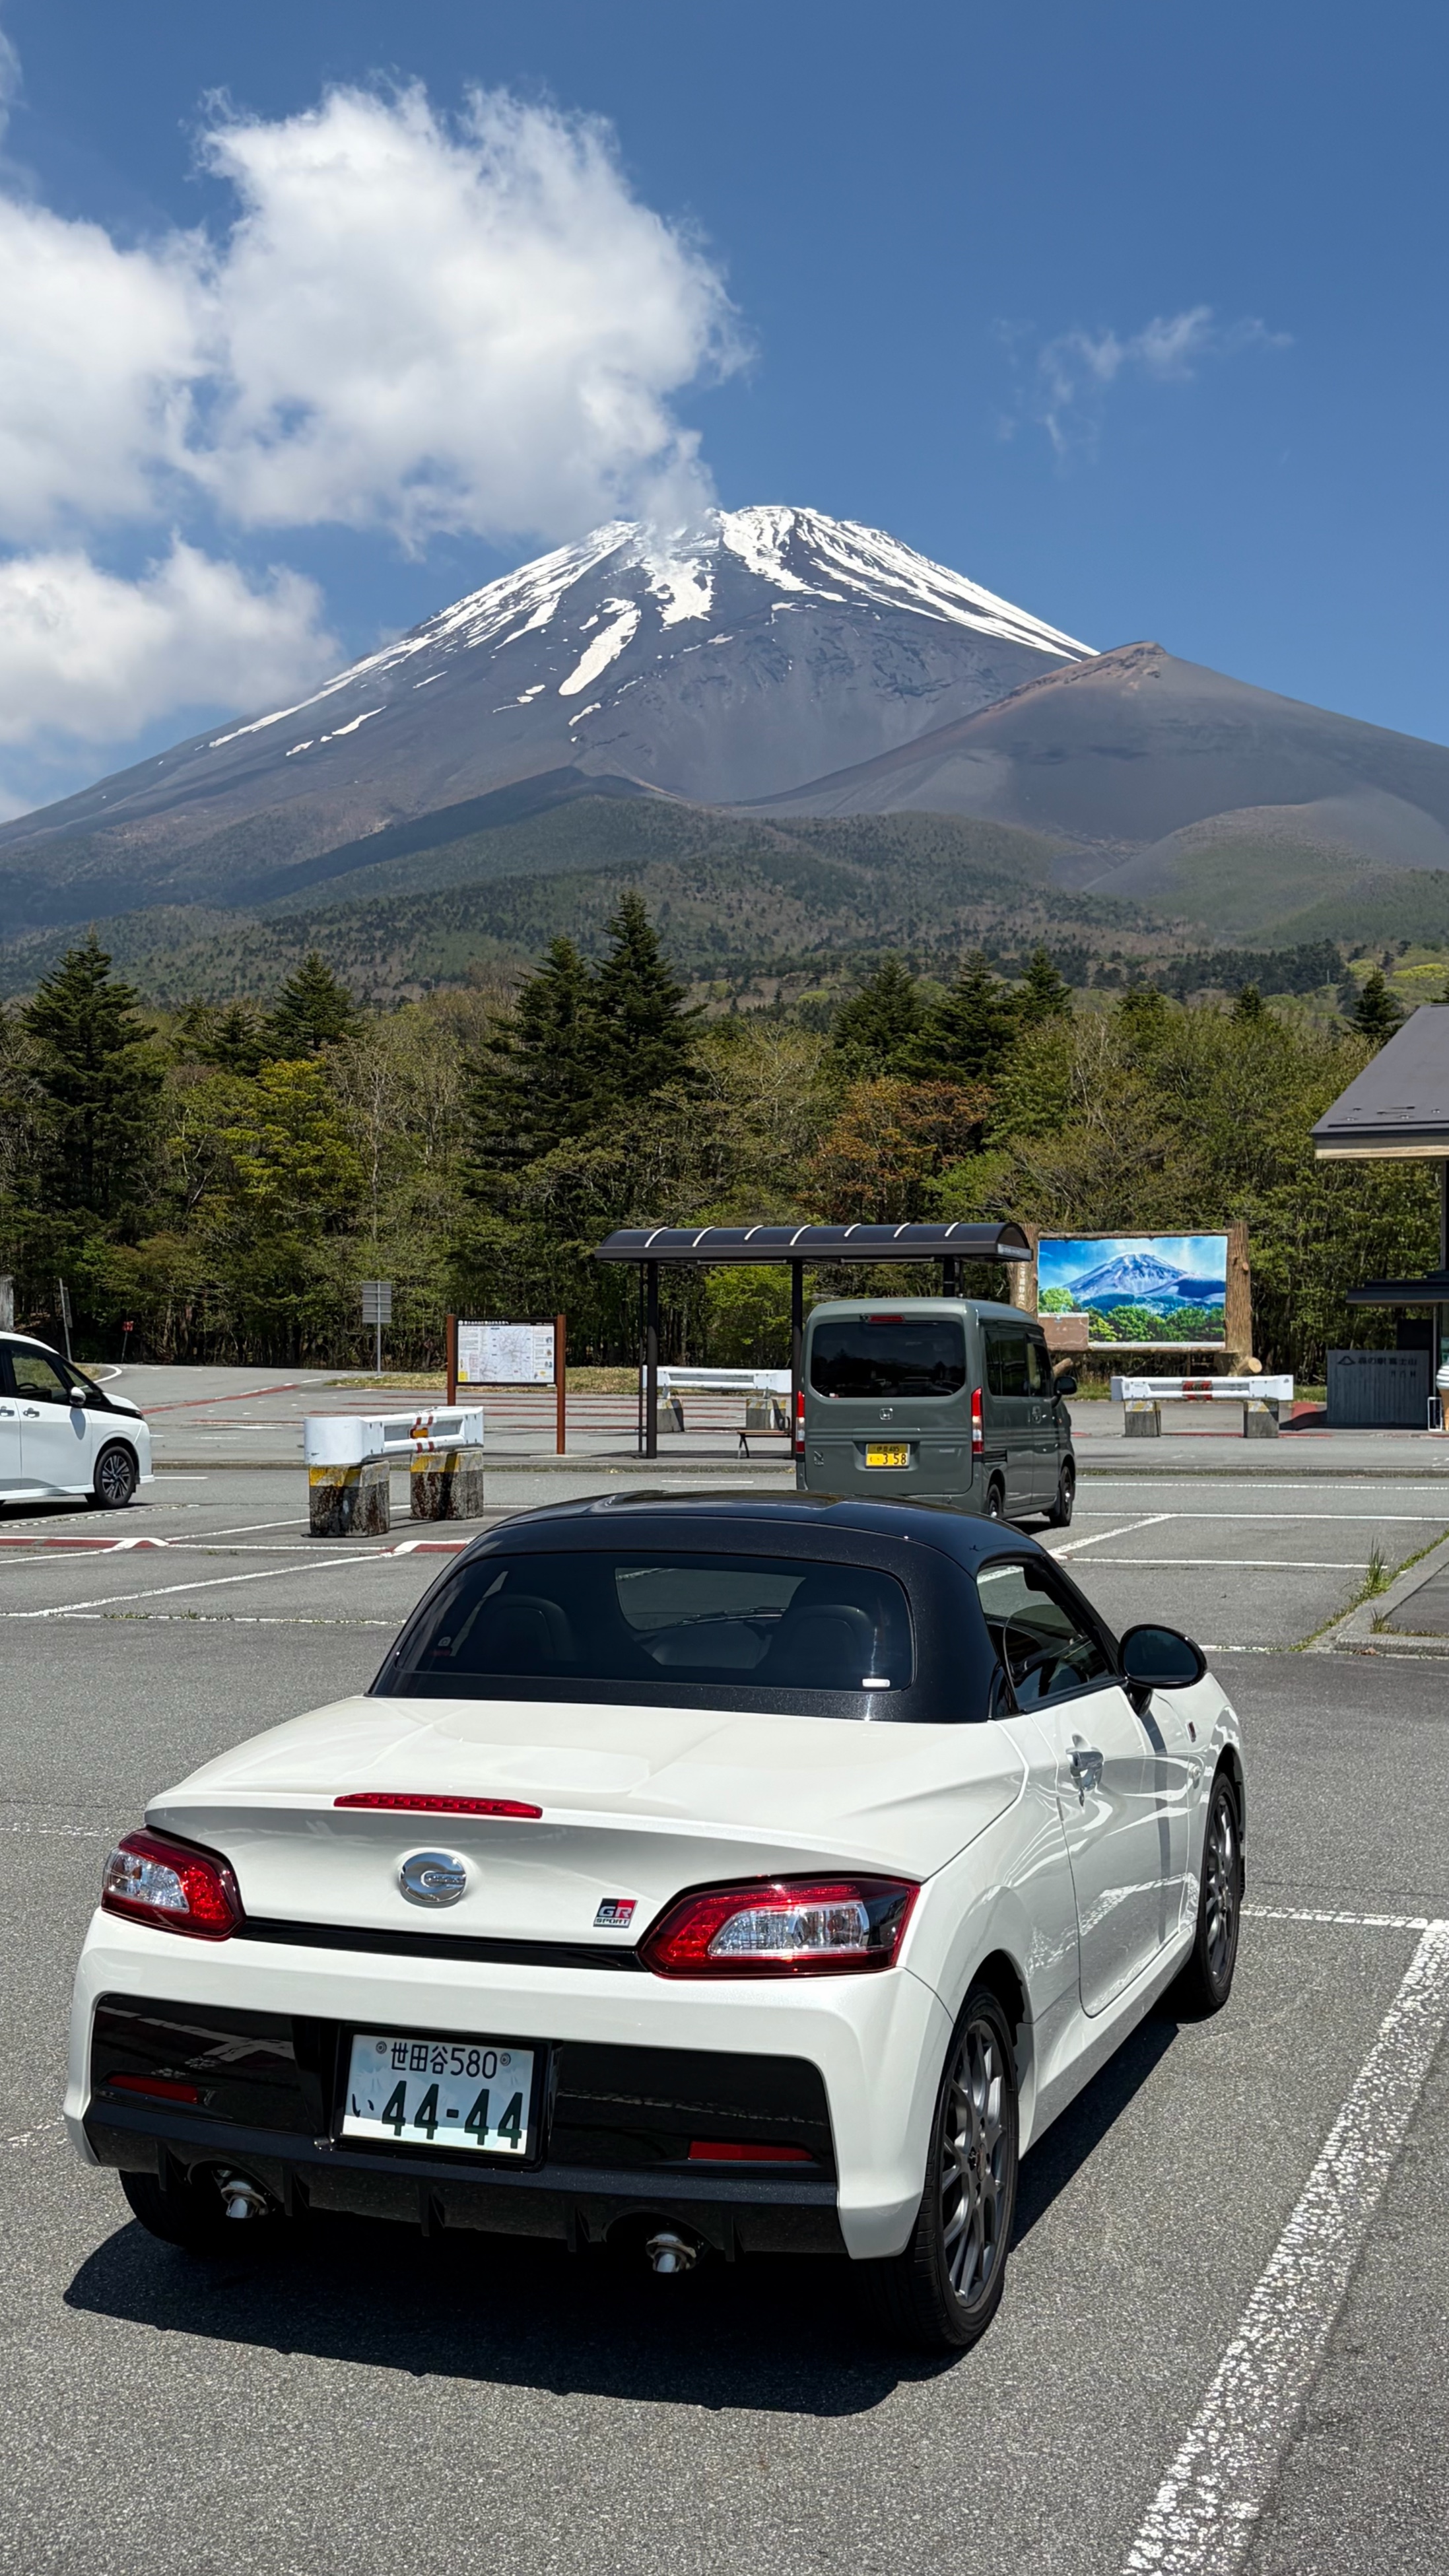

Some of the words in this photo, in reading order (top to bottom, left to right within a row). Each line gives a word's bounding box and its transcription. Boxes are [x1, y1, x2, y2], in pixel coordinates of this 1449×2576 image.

[598, 1906, 632, 1918] GR
[352, 2093, 374, 2118] い
[381, 2080, 523, 2150] 44-44
